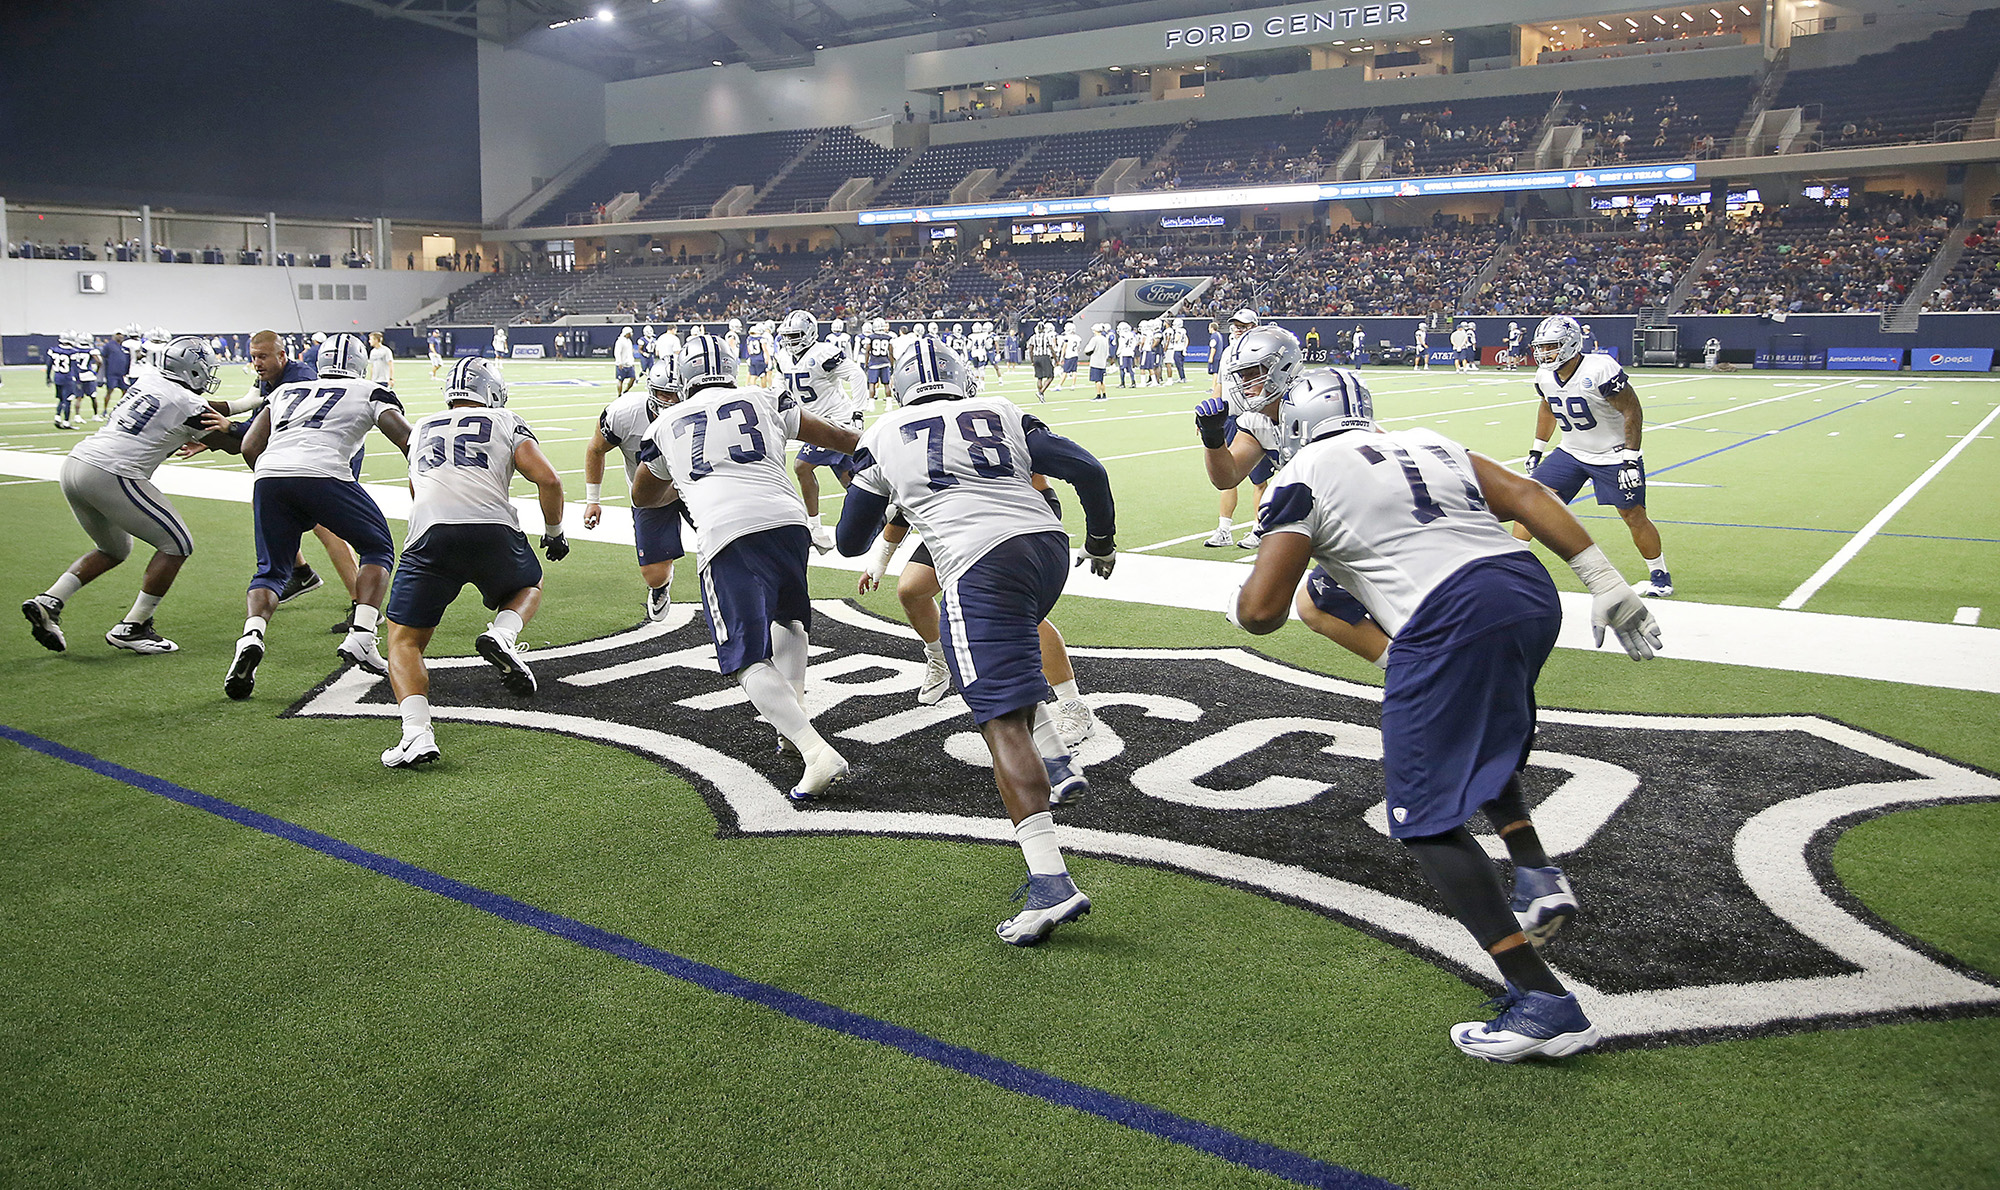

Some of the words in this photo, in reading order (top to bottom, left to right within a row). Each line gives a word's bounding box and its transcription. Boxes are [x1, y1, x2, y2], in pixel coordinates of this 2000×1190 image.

[1166, 22, 1252, 49] FORD
[1263, 2, 1408, 37] CENTER
[1147, 282, 1184, 301] Ford
[872, 340, 889, 356] 99
[1431, 352, 1453, 360] AT&T
[1944, 355, 1973, 364] pepsi
[51, 353, 70, 373] 33
[784, 372, 818, 404] 75
[916, 383, 944, 393] COWBOYS
[275, 388, 347, 432] 77
[1548, 396, 1598, 432] 69
[1341, 420, 1370, 428] COWBOYS
[417, 416, 493, 473] 52
[670, 400, 767, 482] 73
[899, 409, 1015, 494] 78
